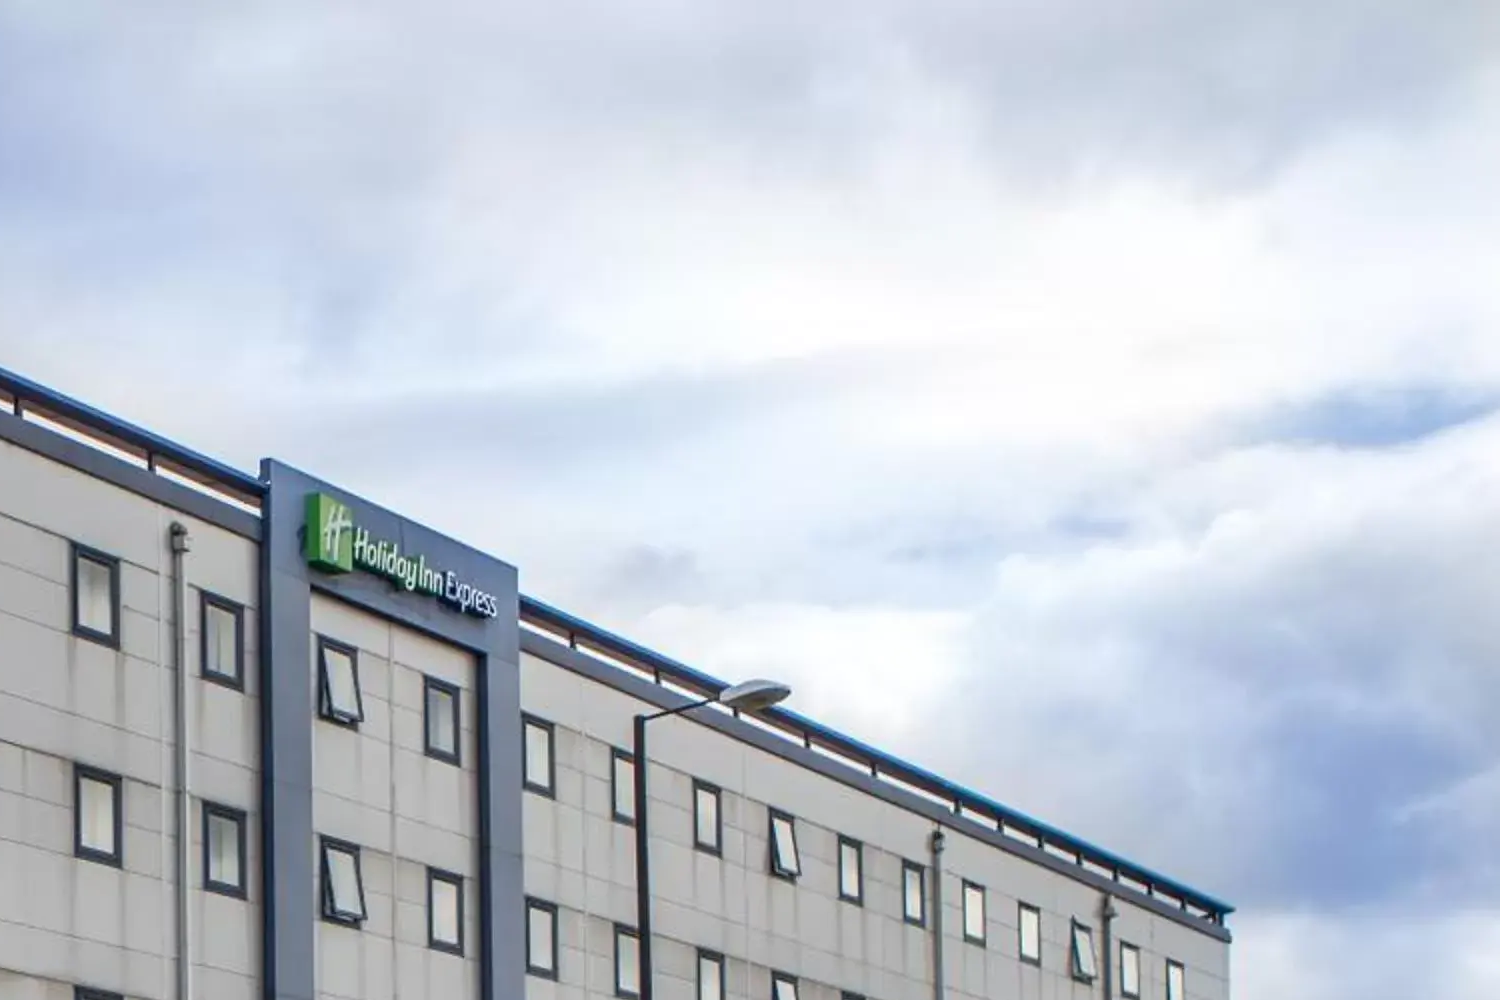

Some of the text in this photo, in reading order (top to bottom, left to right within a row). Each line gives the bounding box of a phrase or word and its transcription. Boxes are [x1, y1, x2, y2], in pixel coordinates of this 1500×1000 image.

[354, 527, 498, 617] Holiday Inn Express
